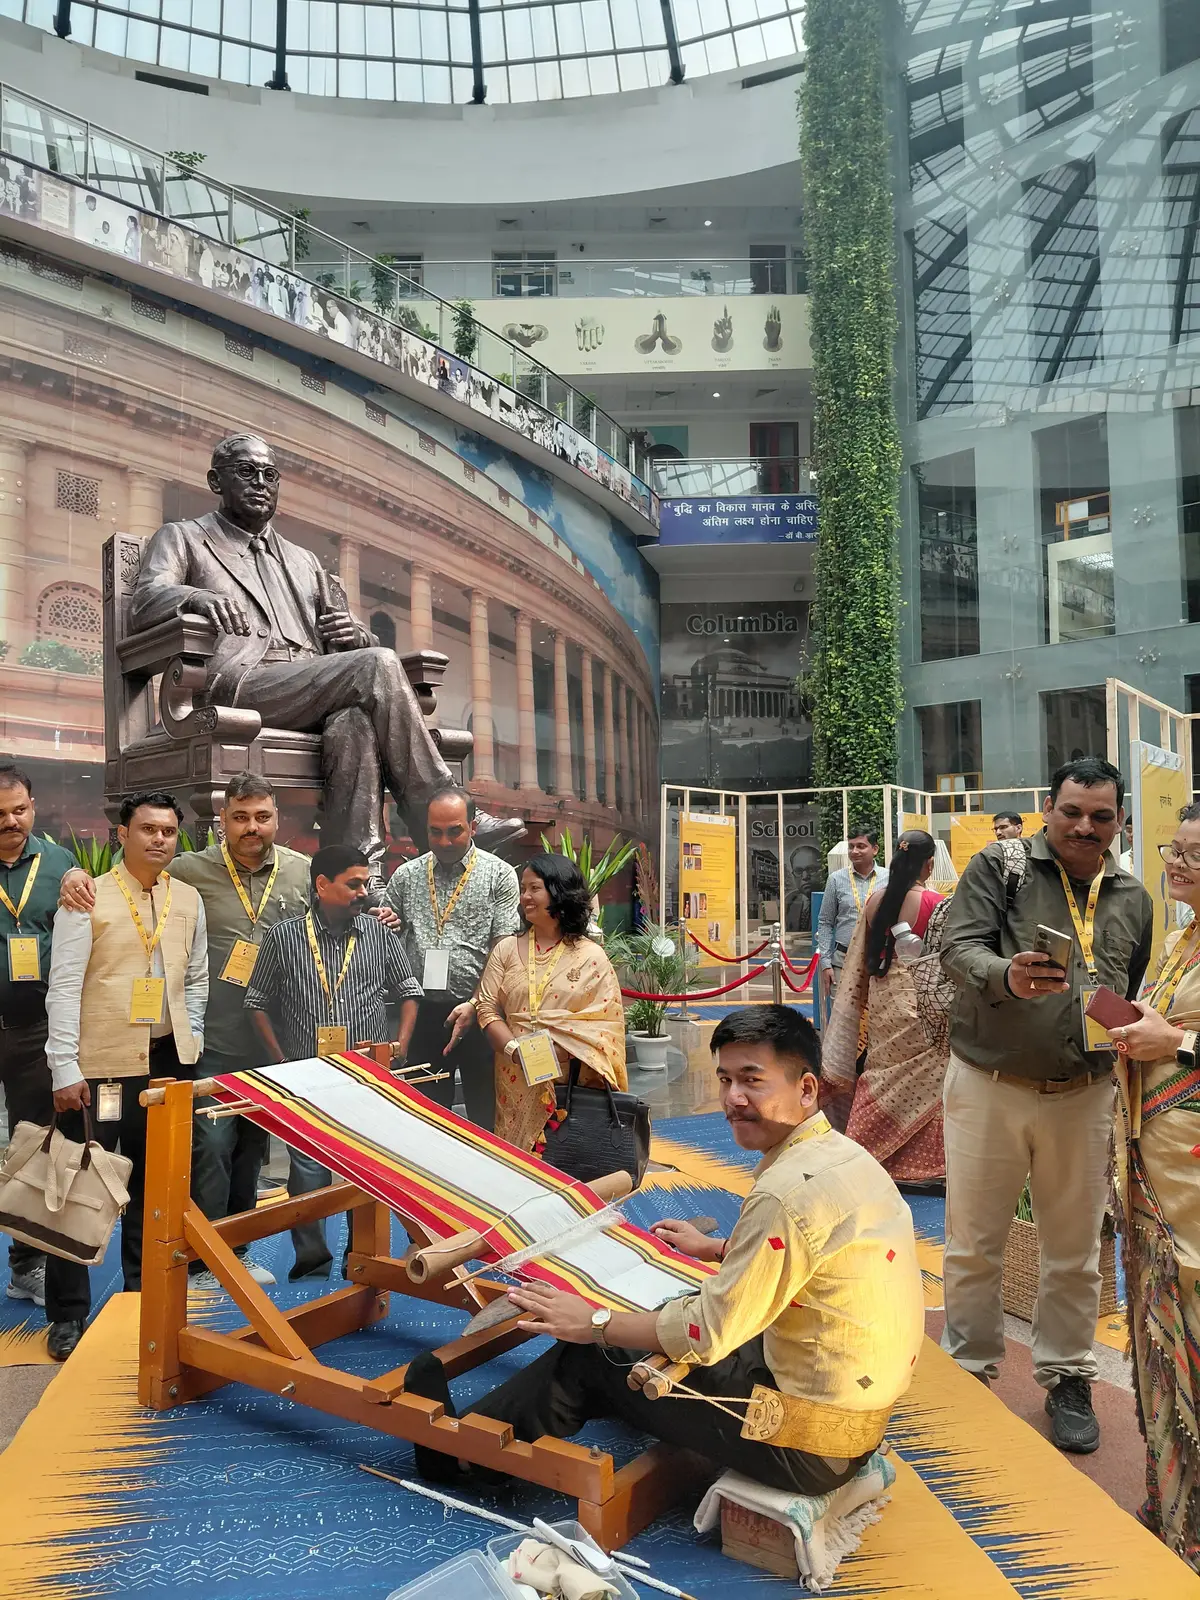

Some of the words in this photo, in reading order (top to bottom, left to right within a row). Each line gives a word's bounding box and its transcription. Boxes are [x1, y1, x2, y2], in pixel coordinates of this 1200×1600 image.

[697, 504, 711, 513] का
[716, 501, 746, 512] विकास
[751, 502, 775, 512] मानव
[780, 499, 790, 511] के
[702, 515, 729, 527] अंतिम
[733, 517, 755, 526] लक्ष्य
[759, 514, 781, 526] होना
[785, 513, 813, 525] चाहिए
[686, 610, 799, 635] Columbia
